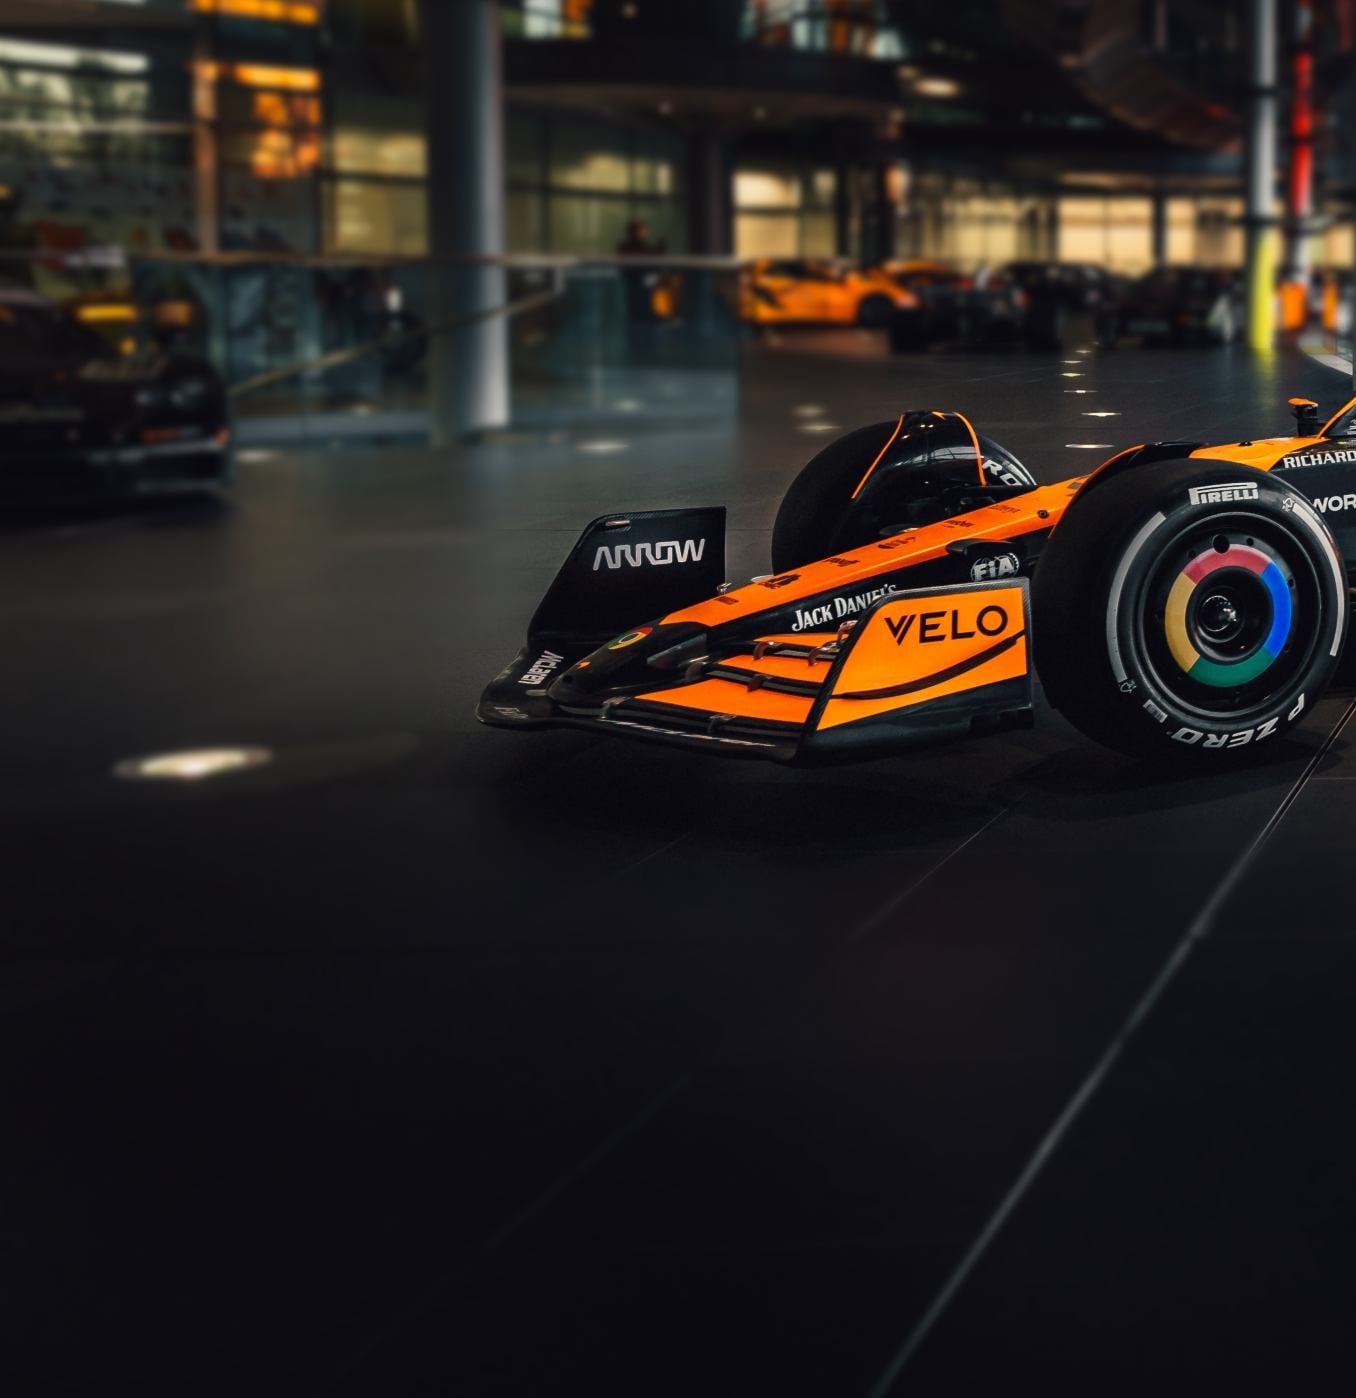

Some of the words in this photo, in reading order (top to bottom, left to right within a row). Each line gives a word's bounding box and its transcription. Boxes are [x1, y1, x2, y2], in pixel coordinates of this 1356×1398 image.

[982, 460, 1023, 486] RO
[1188, 482, 1259, 506] PIRELLI
[593, 538, 706, 571] ARROW
[792, 604, 834, 632] JACK
[884, 605, 1008, 646] VELO
[1288, 692, 1305, 722] P
[1171, 716, 1280, 749] ZERO
